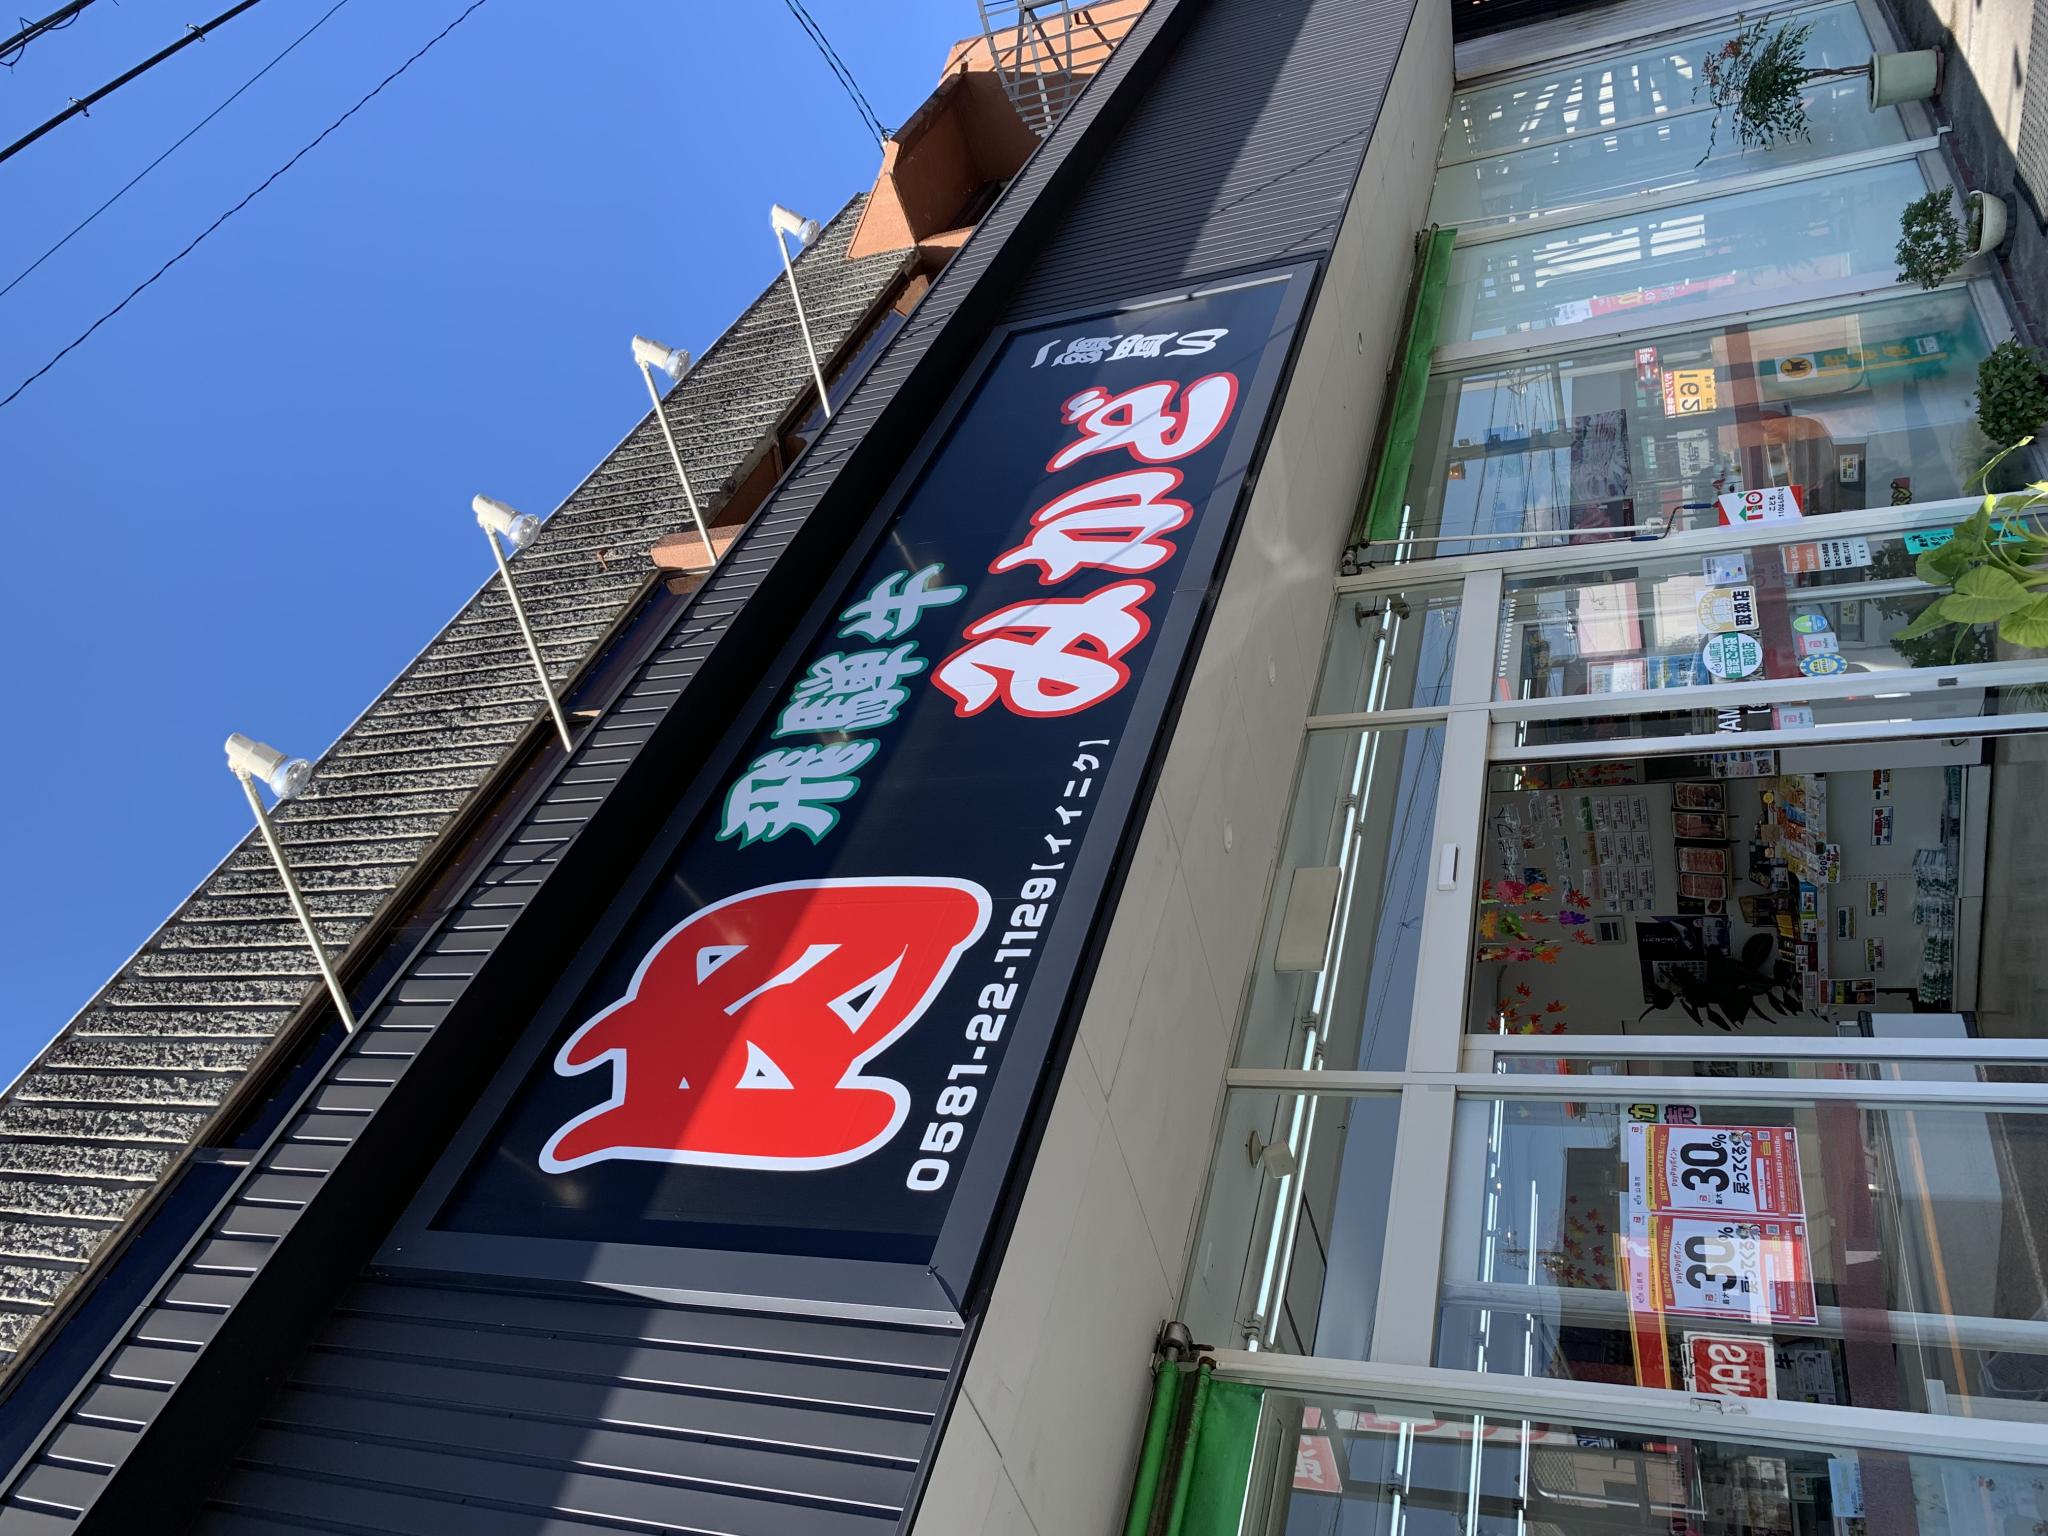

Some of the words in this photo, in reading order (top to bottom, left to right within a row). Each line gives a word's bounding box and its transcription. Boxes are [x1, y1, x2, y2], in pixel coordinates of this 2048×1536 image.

[1768, 495, 1776, 511] こども
[931, 372, 1238, 718] みかど
[1732, 590, 1753, 626] 取扱店
[1708, 643, 1721, 663] 山県市
[1724, 637, 1741, 673] 指定ごみ袋
[1742, 642, 1758, 666] 取扱店
[715, 564, 967, 849] 飛騨牛
[906, 877, 1057, 1191] 0581-22-1129
[1731, 1146, 1750, 1195] 戻ってくる
